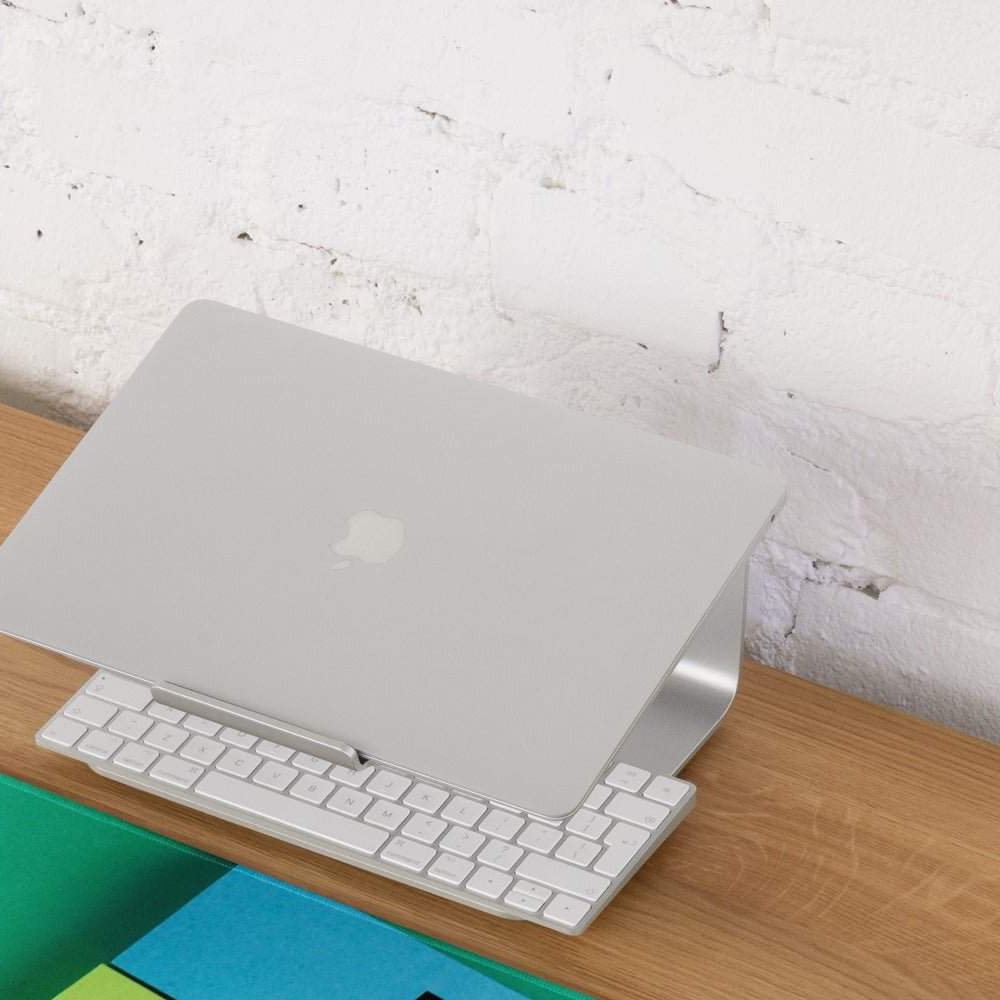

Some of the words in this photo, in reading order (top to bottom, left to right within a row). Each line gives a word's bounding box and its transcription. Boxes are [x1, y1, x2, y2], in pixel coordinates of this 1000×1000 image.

[161, 733, 171, 742] Z
[235, 759, 244, 767] C
[272, 771, 281, 779] V
[307, 784, 317, 792] B
[422, 793, 431, 801] K
[345, 797, 355, 806] N
[381, 810, 393, 819] M
[459, 807, 466, 815] L
[387, 851, 421, 866] command
